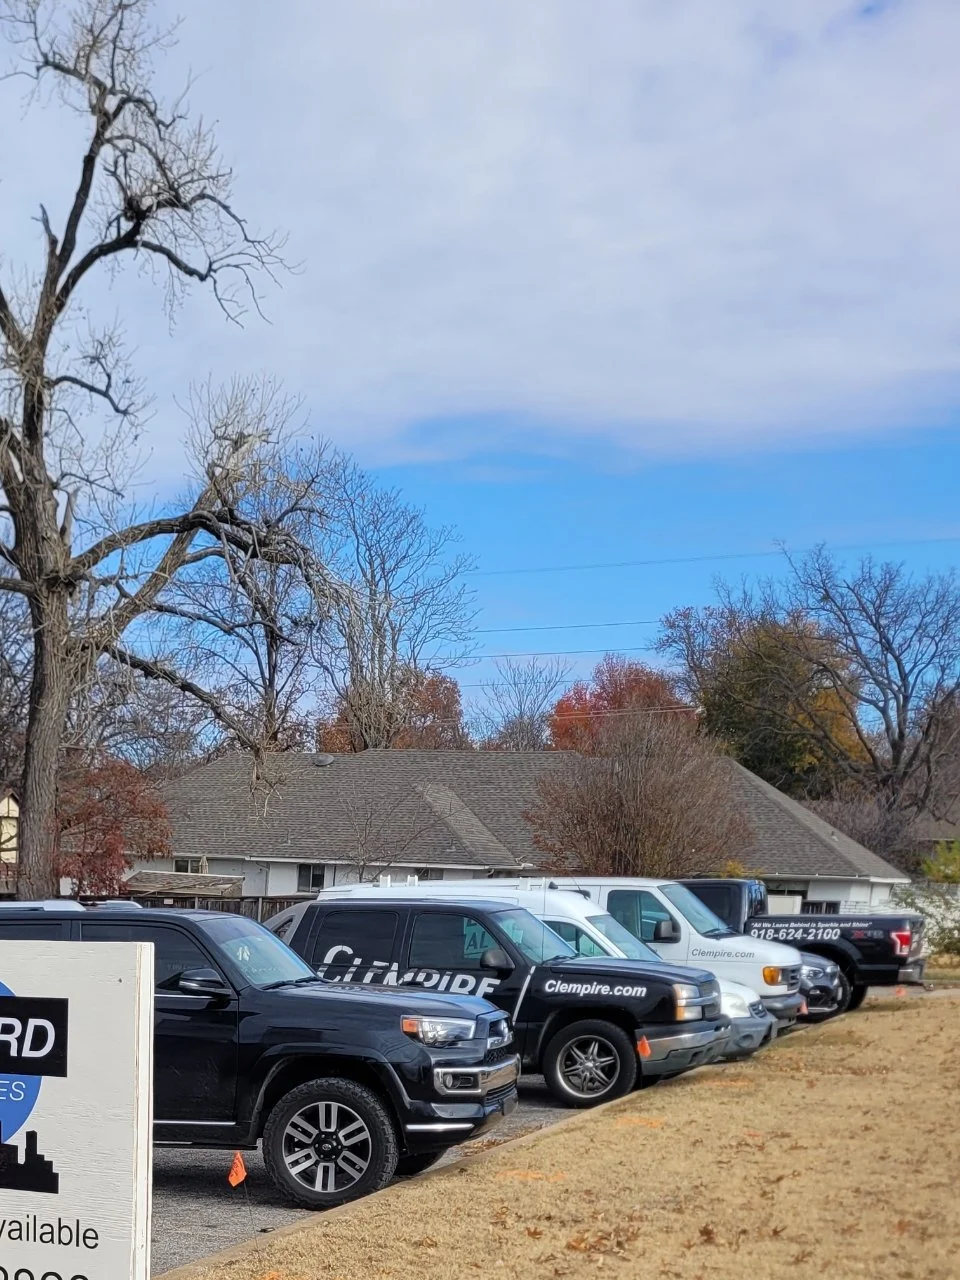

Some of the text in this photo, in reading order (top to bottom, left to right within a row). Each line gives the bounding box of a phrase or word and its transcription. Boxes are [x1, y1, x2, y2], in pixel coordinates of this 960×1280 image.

[751, 928, 840, 940] 918-624-2100
[691, 948, 755, 958] Clempire.com
[544, 980, 647, 997] Clempire.com
